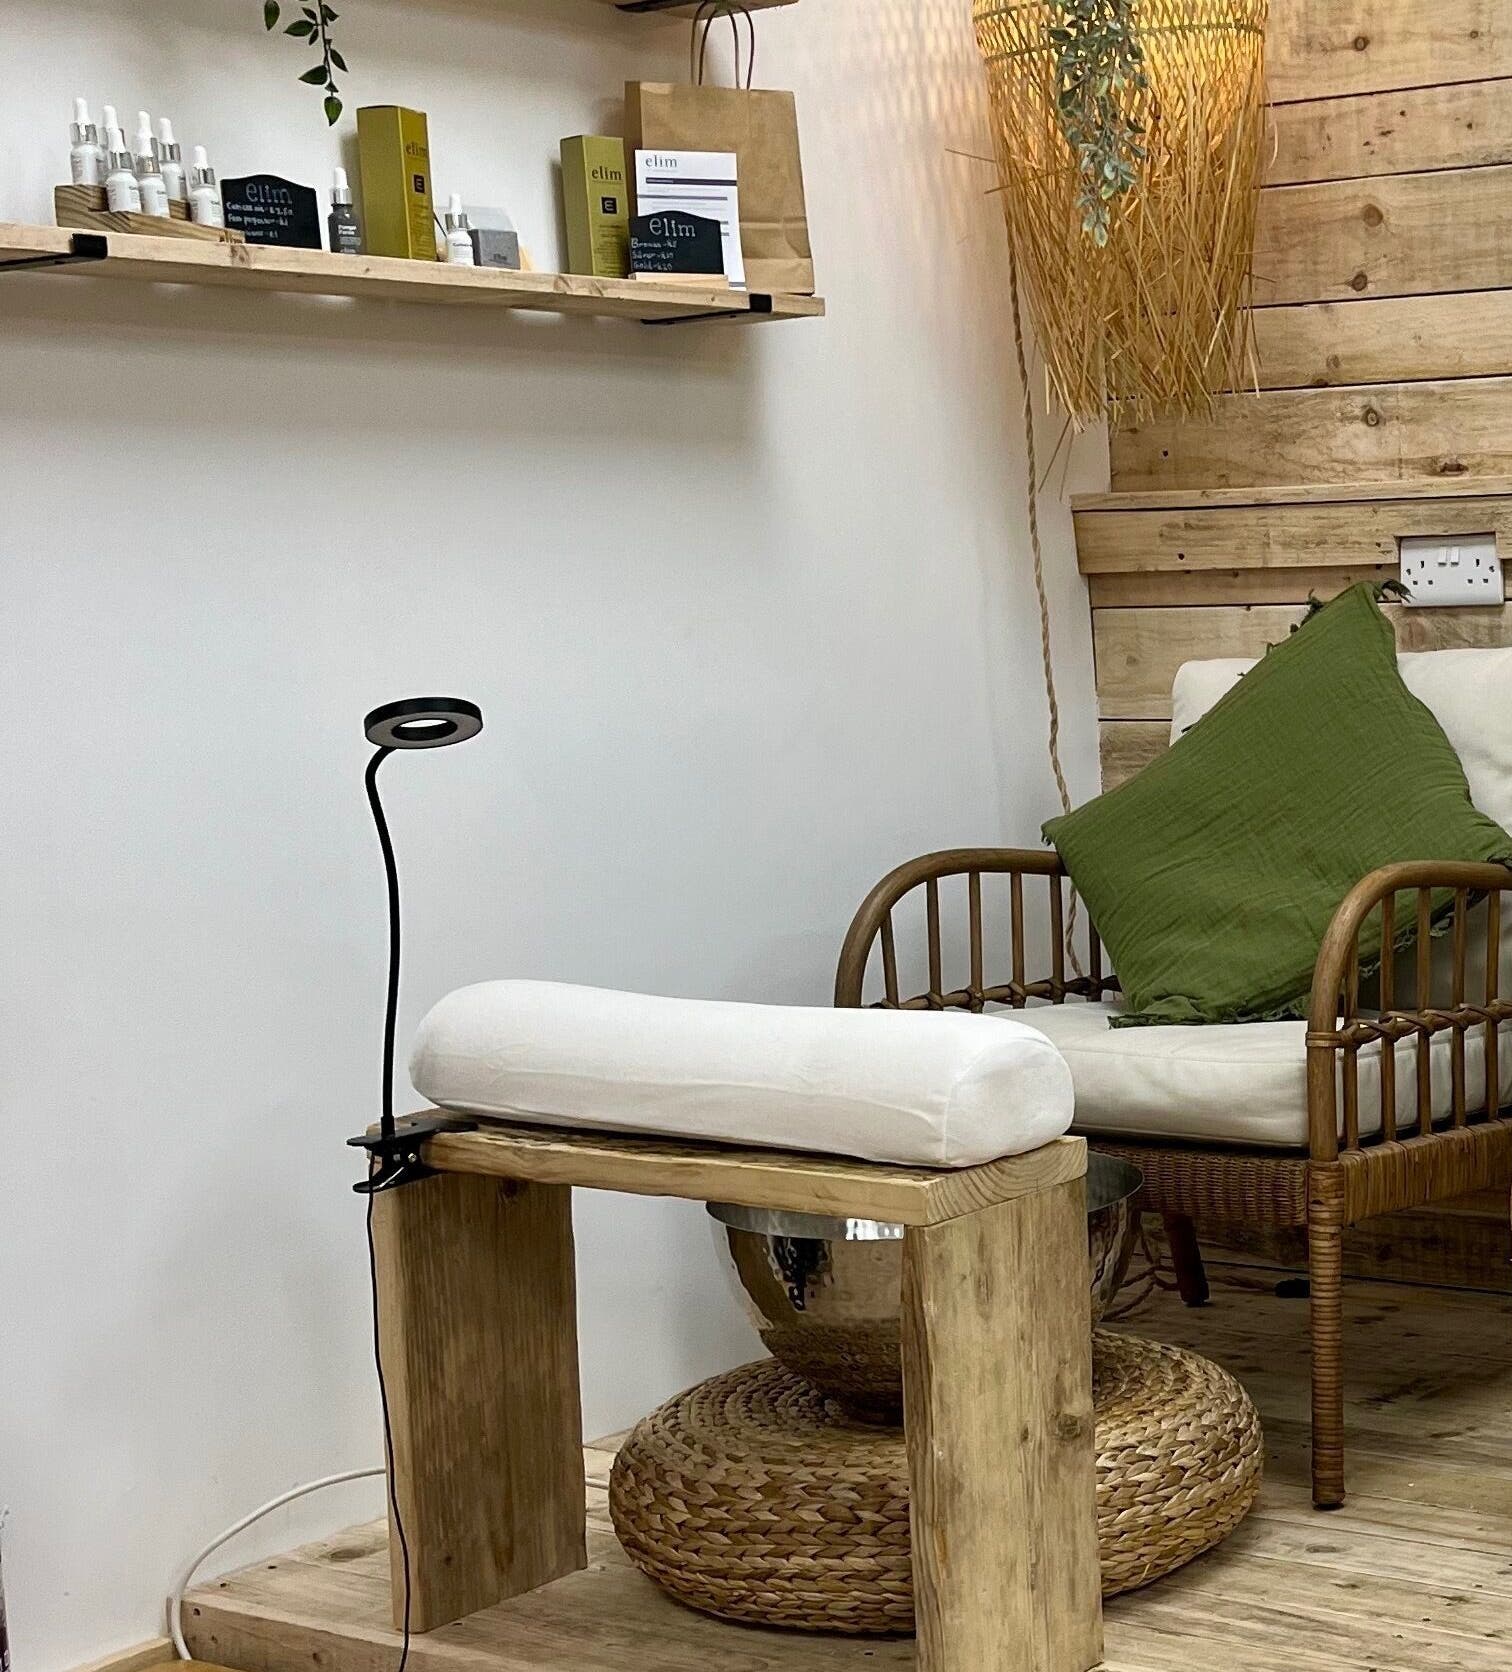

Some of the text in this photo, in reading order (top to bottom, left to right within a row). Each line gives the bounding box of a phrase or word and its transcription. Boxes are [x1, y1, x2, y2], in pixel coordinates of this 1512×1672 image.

[645, 155, 677, 168] elim
[591, 165, 622, 181] elim
[246, 183, 292, 204] elim
[649, 217, 696, 237] elim
